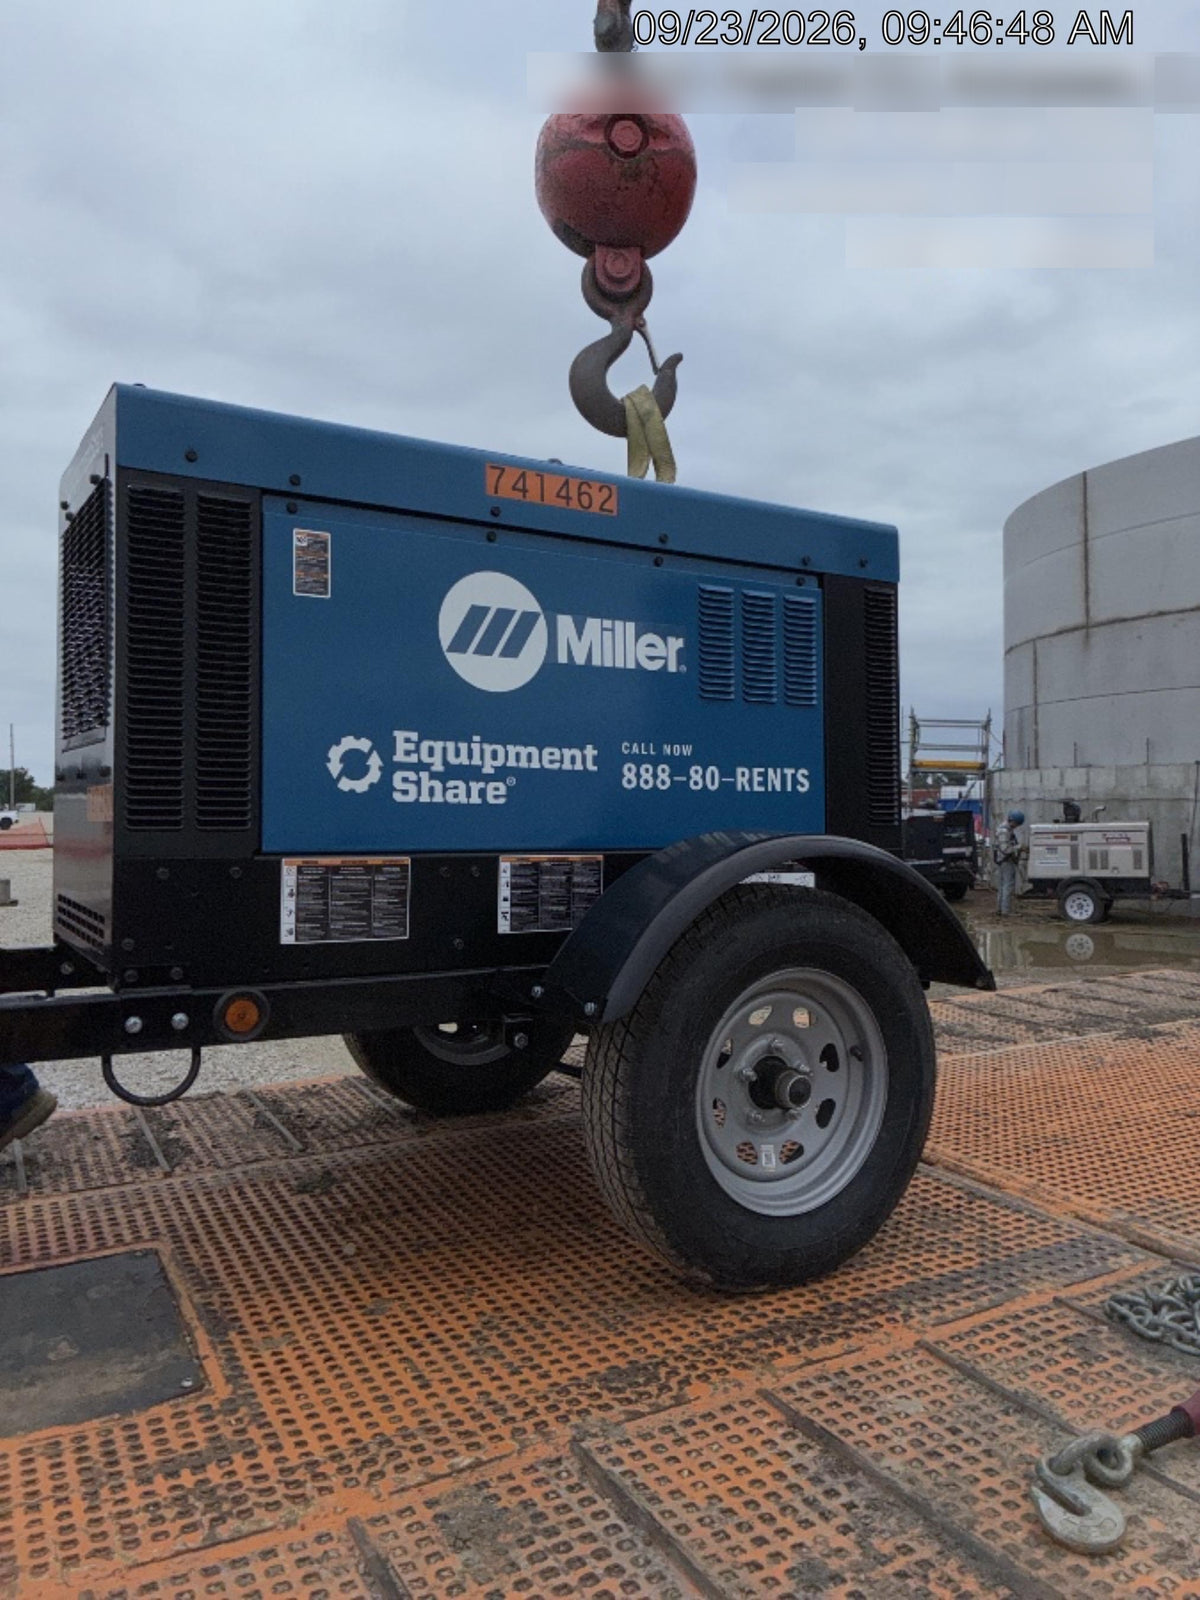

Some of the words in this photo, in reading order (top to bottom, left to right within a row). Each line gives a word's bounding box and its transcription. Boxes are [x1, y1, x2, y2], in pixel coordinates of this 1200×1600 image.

[489, 466, 614, 514] 741462
[556, 616, 686, 673] Miller
[393, 730, 598, 773] Equipment
[621, 742, 658, 755] CALL
[663, 743, 693, 756] NOW
[621, 762, 811, 793] 888-80-RENTS
